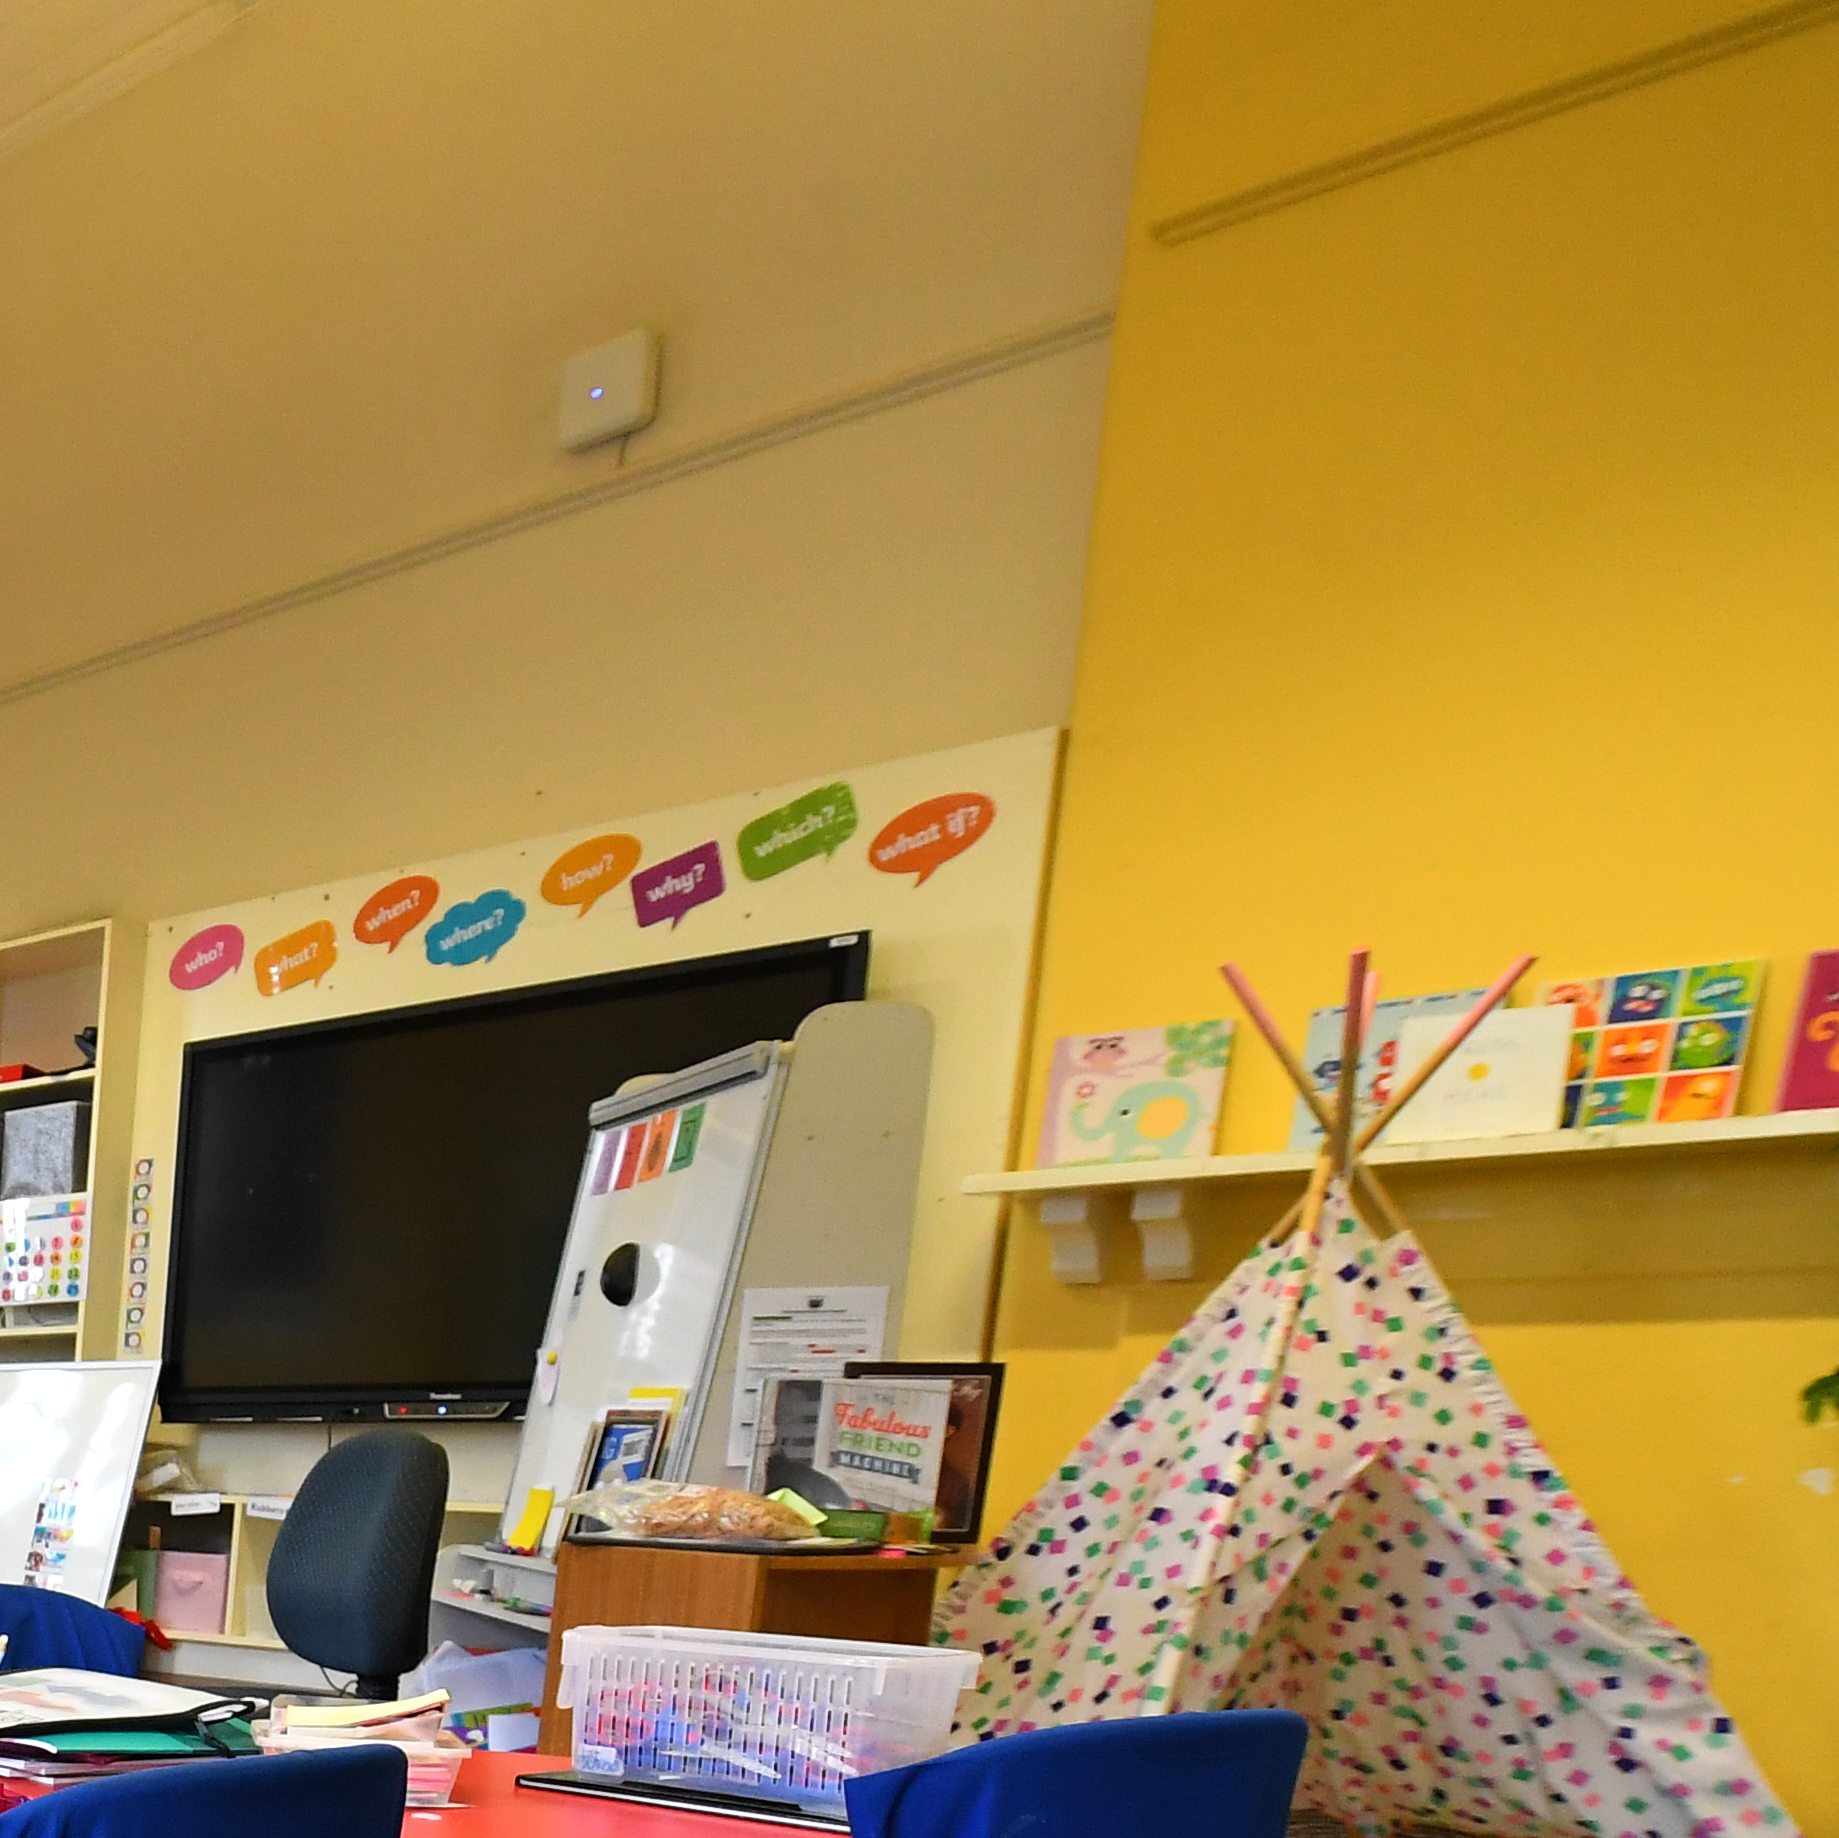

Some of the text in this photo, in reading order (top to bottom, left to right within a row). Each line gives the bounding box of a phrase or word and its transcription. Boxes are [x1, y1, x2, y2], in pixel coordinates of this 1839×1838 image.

[755, 805, 835, 858] which?
[876, 804, 980, 863] what if?
[561, 854, 615, 891] how?
[646, 862, 707, 904] why?
[365, 891, 422, 931] when?
[440, 909, 508, 953] where?
[184, 943, 225, 975] who?
[834, 1403, 931, 1439] Fabulous
[839, 1431, 922, 1458] FRIEND
